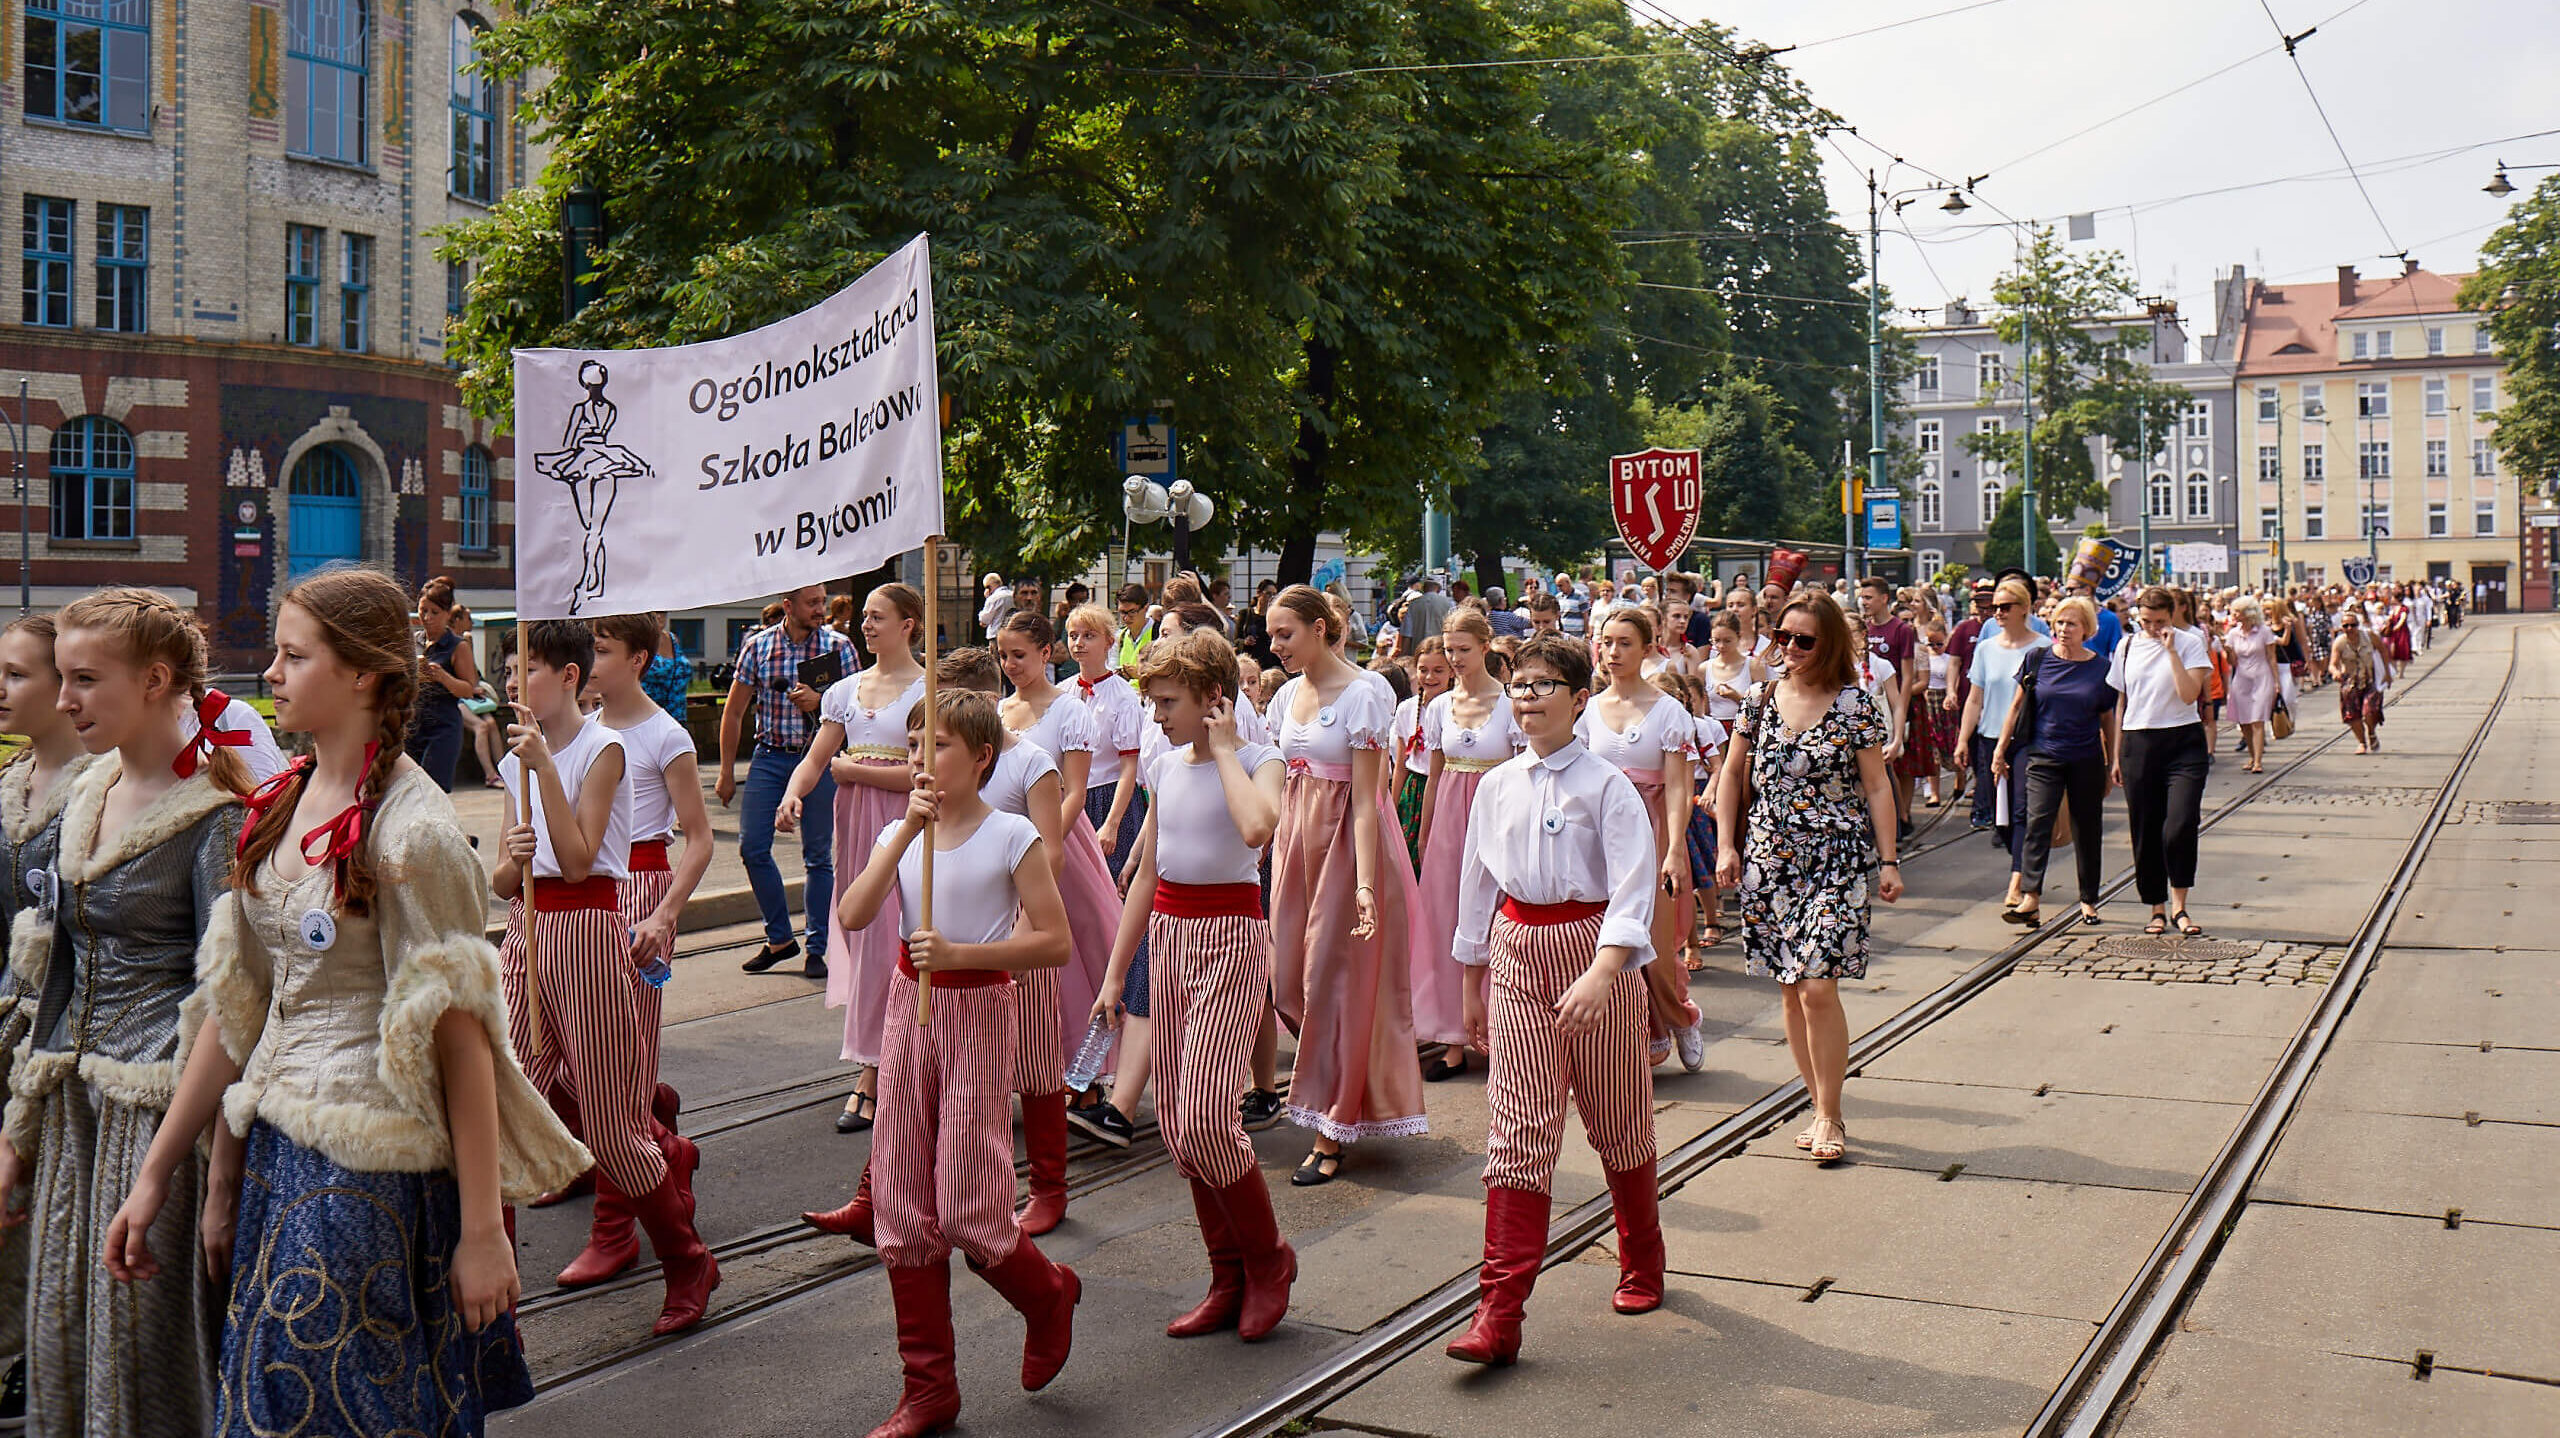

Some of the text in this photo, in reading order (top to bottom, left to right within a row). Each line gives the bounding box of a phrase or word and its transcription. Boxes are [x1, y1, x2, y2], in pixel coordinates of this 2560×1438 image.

[698, 434, 810, 491] Szkoła
[1621, 456, 1691, 481] BYTOM
[1674, 479, 1695, 511] LO
[754, 527, 786, 557] w
[1627, 535, 1652, 561] JANA
